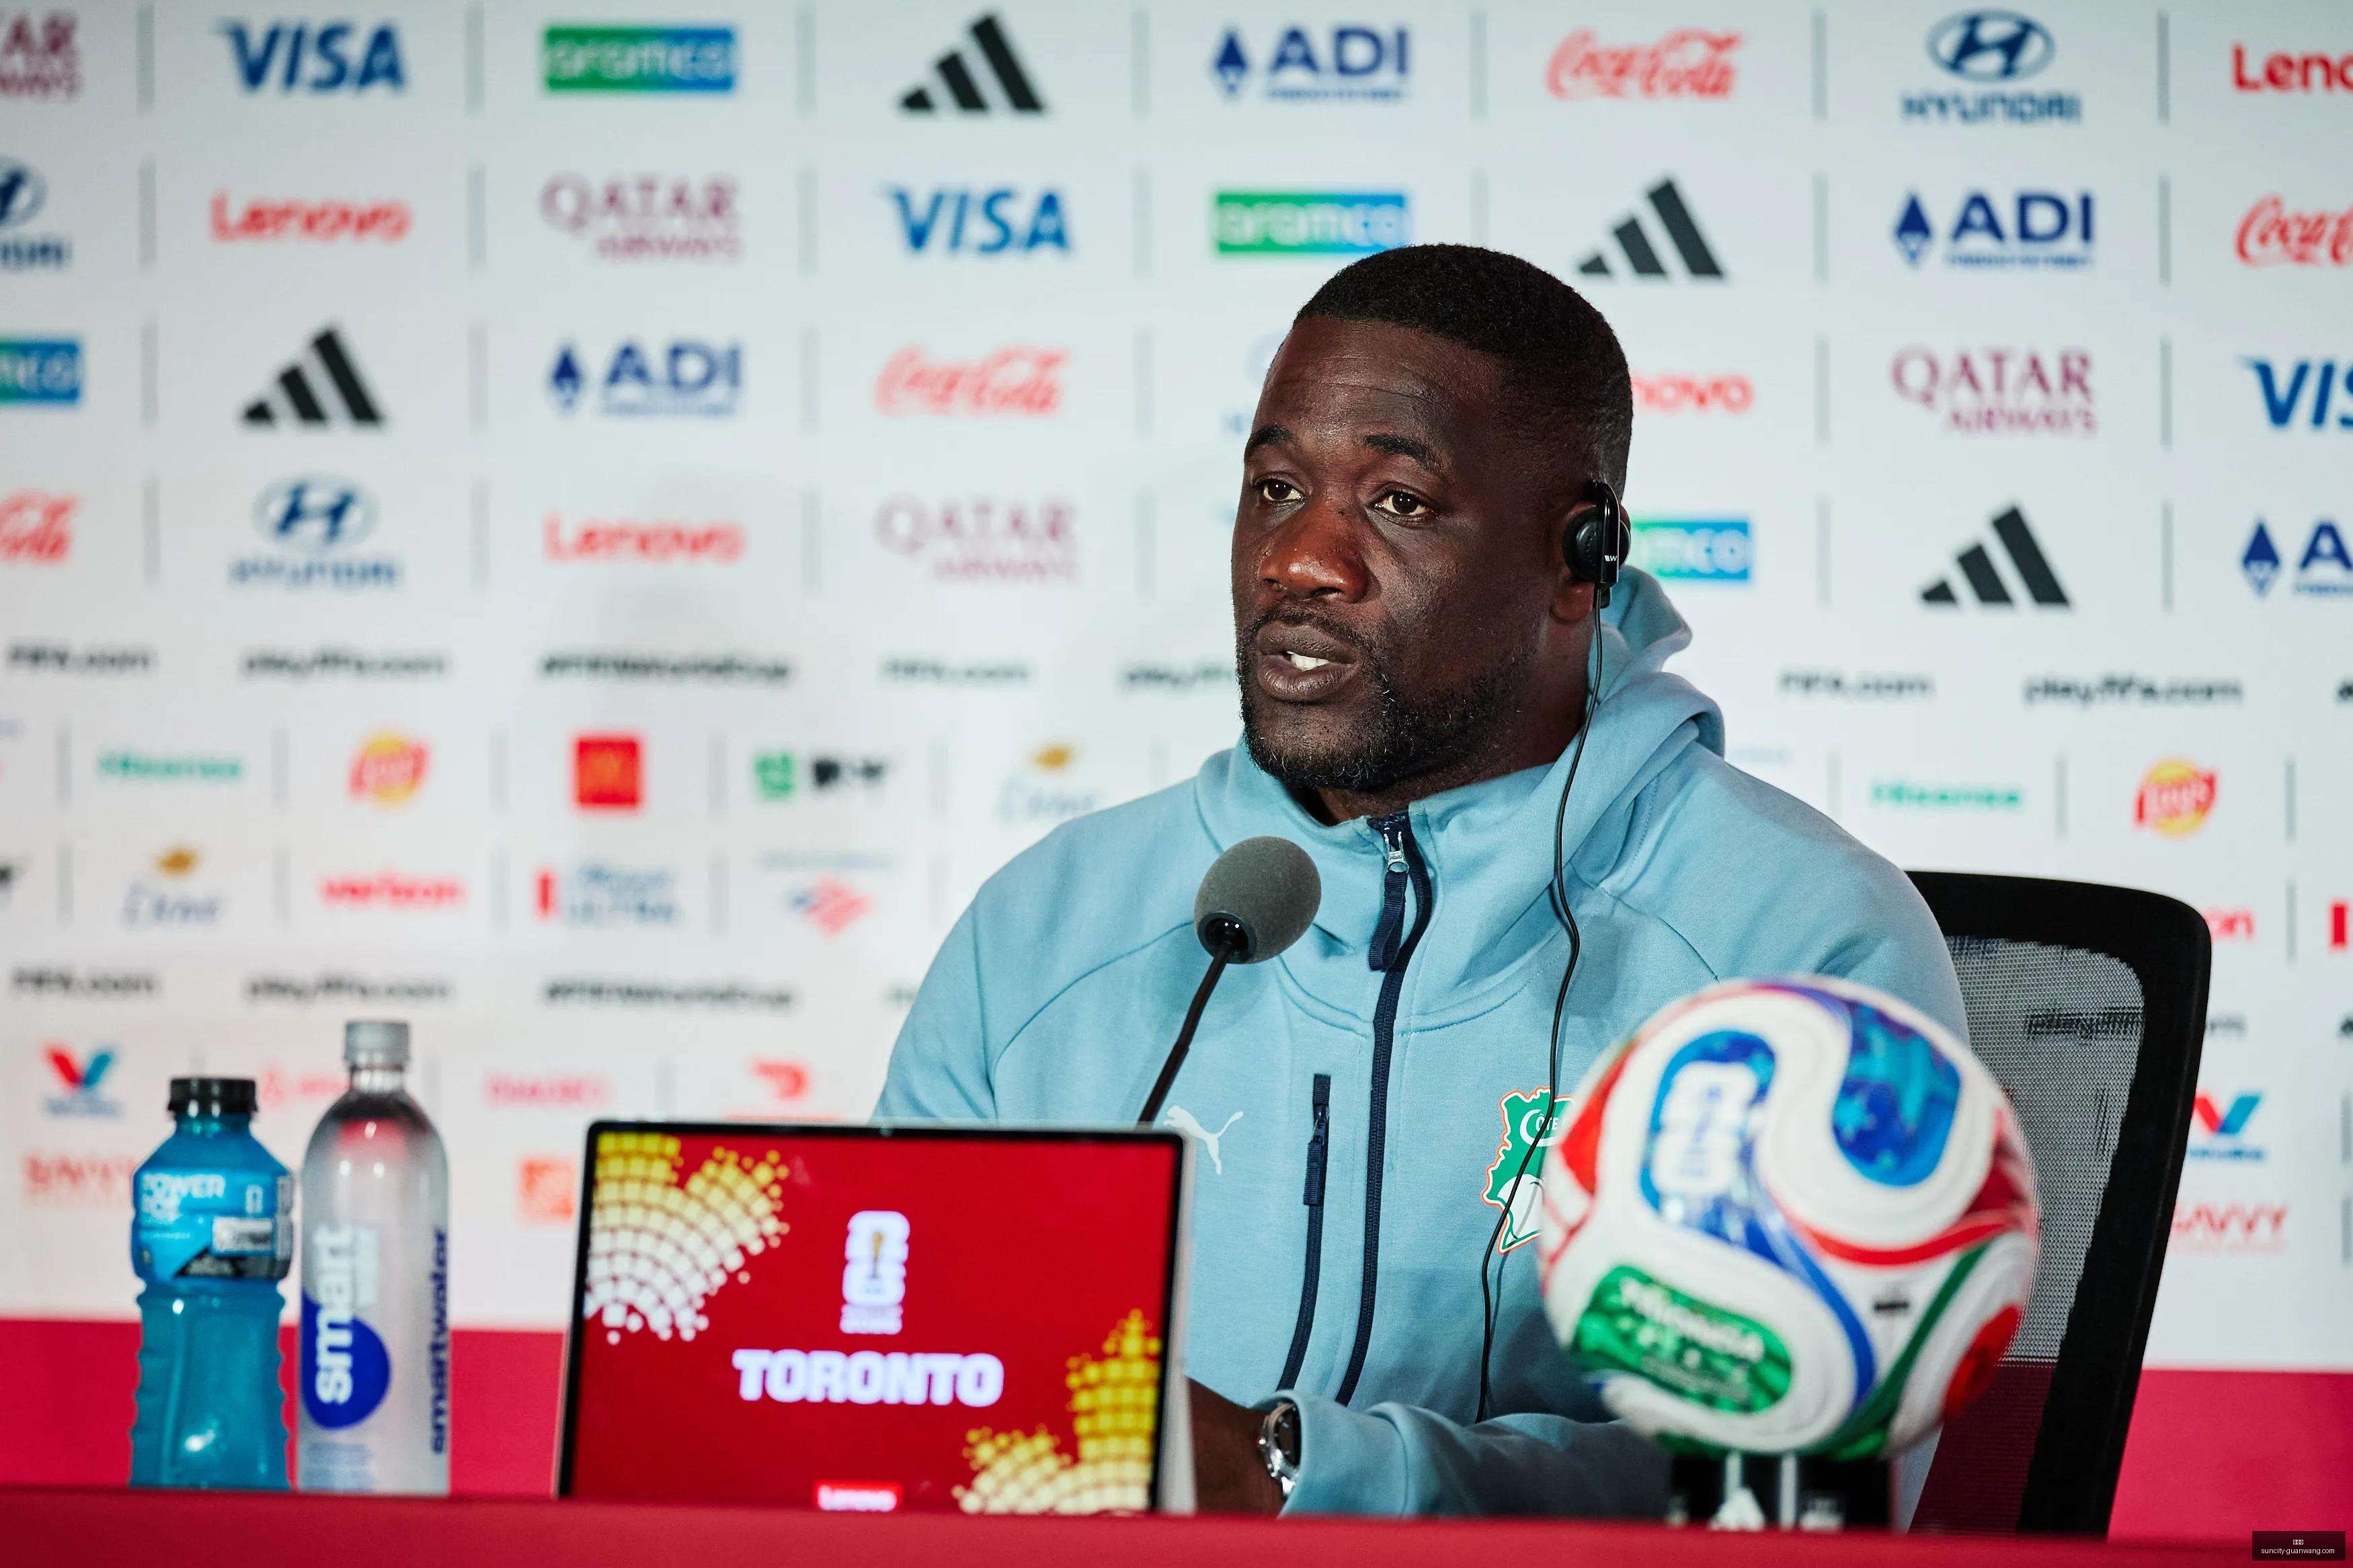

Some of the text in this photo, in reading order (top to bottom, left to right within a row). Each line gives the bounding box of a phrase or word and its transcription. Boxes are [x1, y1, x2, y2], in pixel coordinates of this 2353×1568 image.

[215, 20, 407, 92] VISA
[1269, 27, 1410, 75] ADI
[2232, 43, 2353, 93] Len
[210, 191, 411, 242] Lenovo
[541, 173, 737, 233] QATAR
[882, 187, 1070, 254] VISA
[1950, 191, 2096, 243] ADI
[605, 341, 742, 390] ADI
[1891, 345, 2092, 407] QATAR
[1631, 375, 1753, 414] novo
[543, 515, 745, 563] Lenovo
[313, 1225, 354, 1405] smart
[429, 1226, 449, 1454] smartwater
[732, 1349, 1004, 1407] TORONTO
